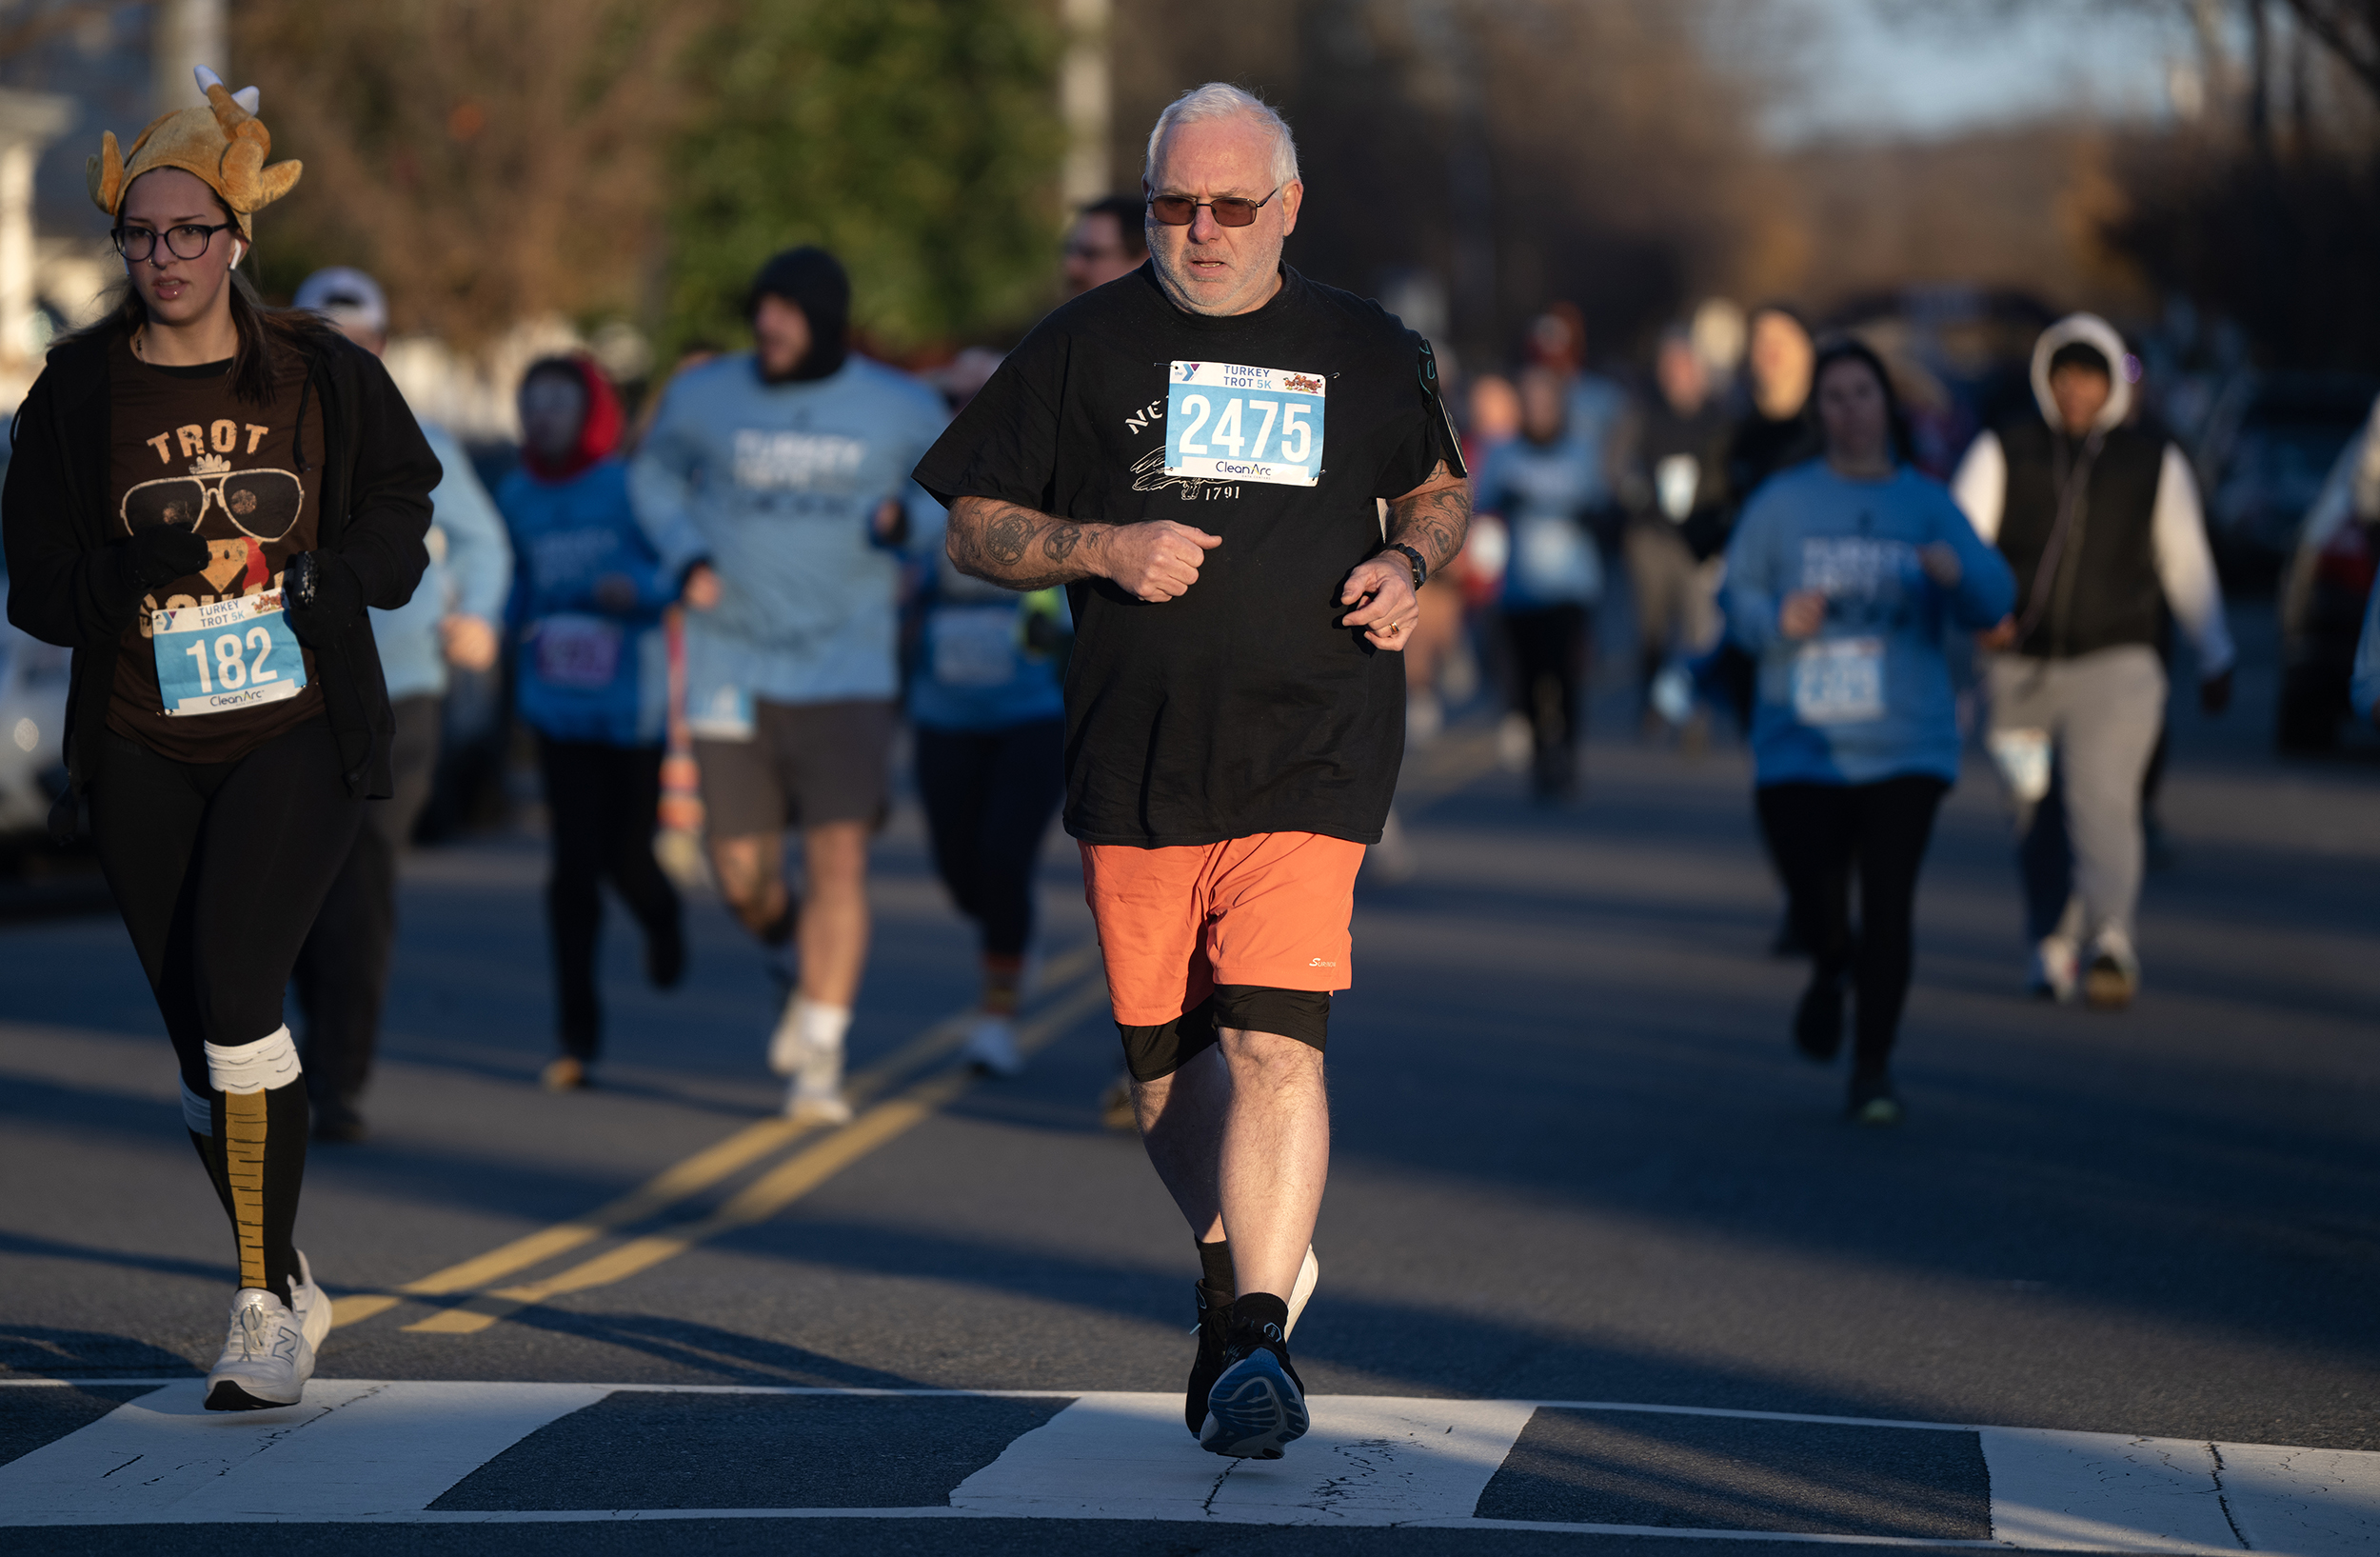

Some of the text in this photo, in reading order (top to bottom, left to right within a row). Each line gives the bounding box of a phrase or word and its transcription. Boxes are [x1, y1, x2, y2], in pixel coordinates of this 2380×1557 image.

[1223, 365, 1270, 378] TURKEY
[1223, 376, 1272, 389] TROT 5K
[1124, 395, 1169, 435] NE
[1179, 393, 1312, 463] 2475
[146, 419, 269, 465] TROT
[1215, 461, 1272, 476] CleanArc
[1205, 486, 1240, 501] 1791
[199, 599, 239, 617] TURKEY
[200, 609, 246, 628] TROT 5K
[186, 626, 278, 693] 182
